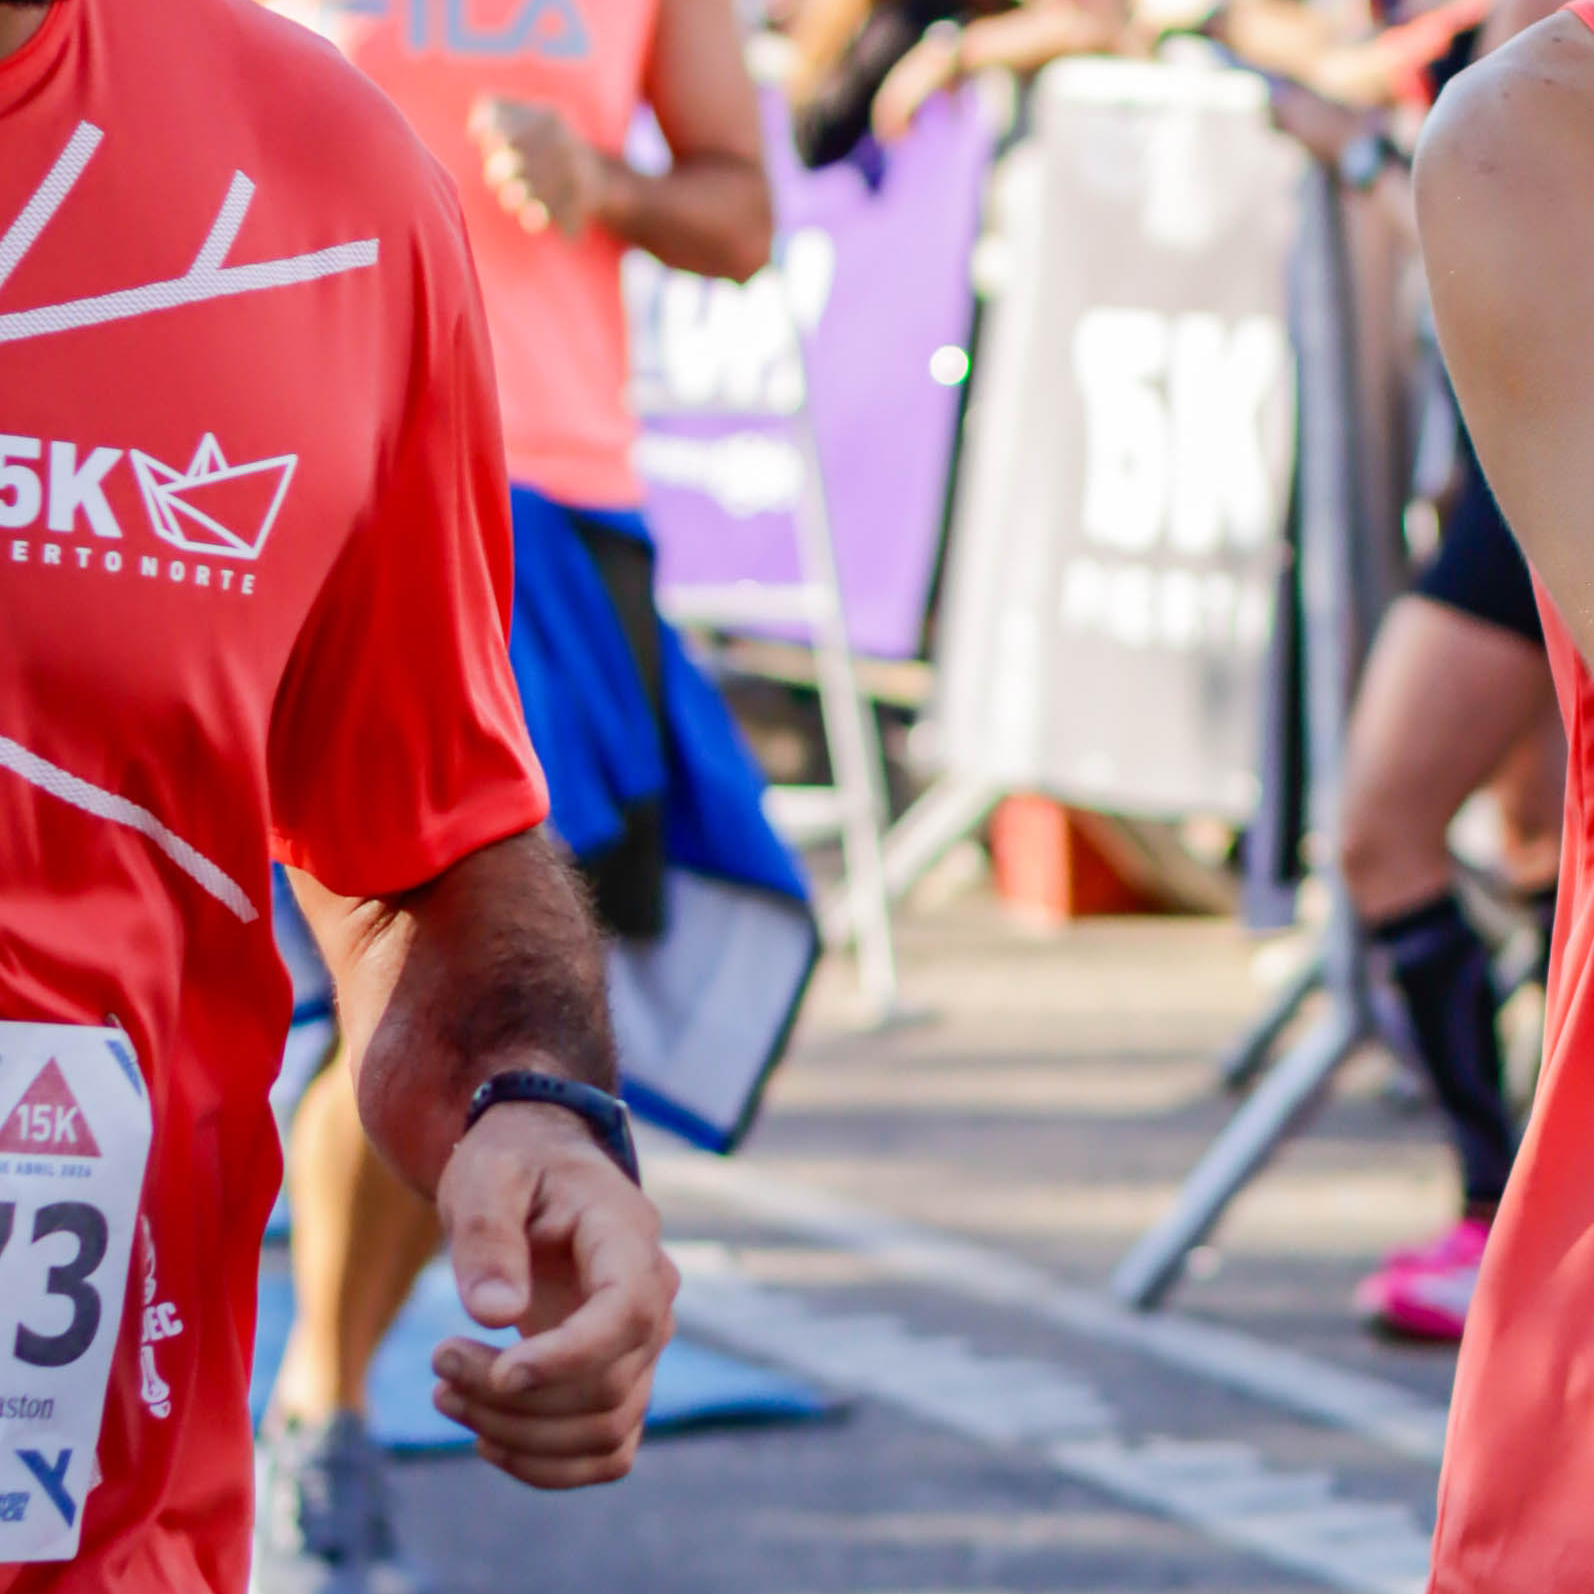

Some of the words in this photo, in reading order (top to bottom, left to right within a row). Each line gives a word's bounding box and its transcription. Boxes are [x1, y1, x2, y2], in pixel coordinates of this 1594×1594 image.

[0, 433, 124, 539] 5K
[140, 555, 257, 595] NORTE
[16, 1104, 78, 1144] 15K
